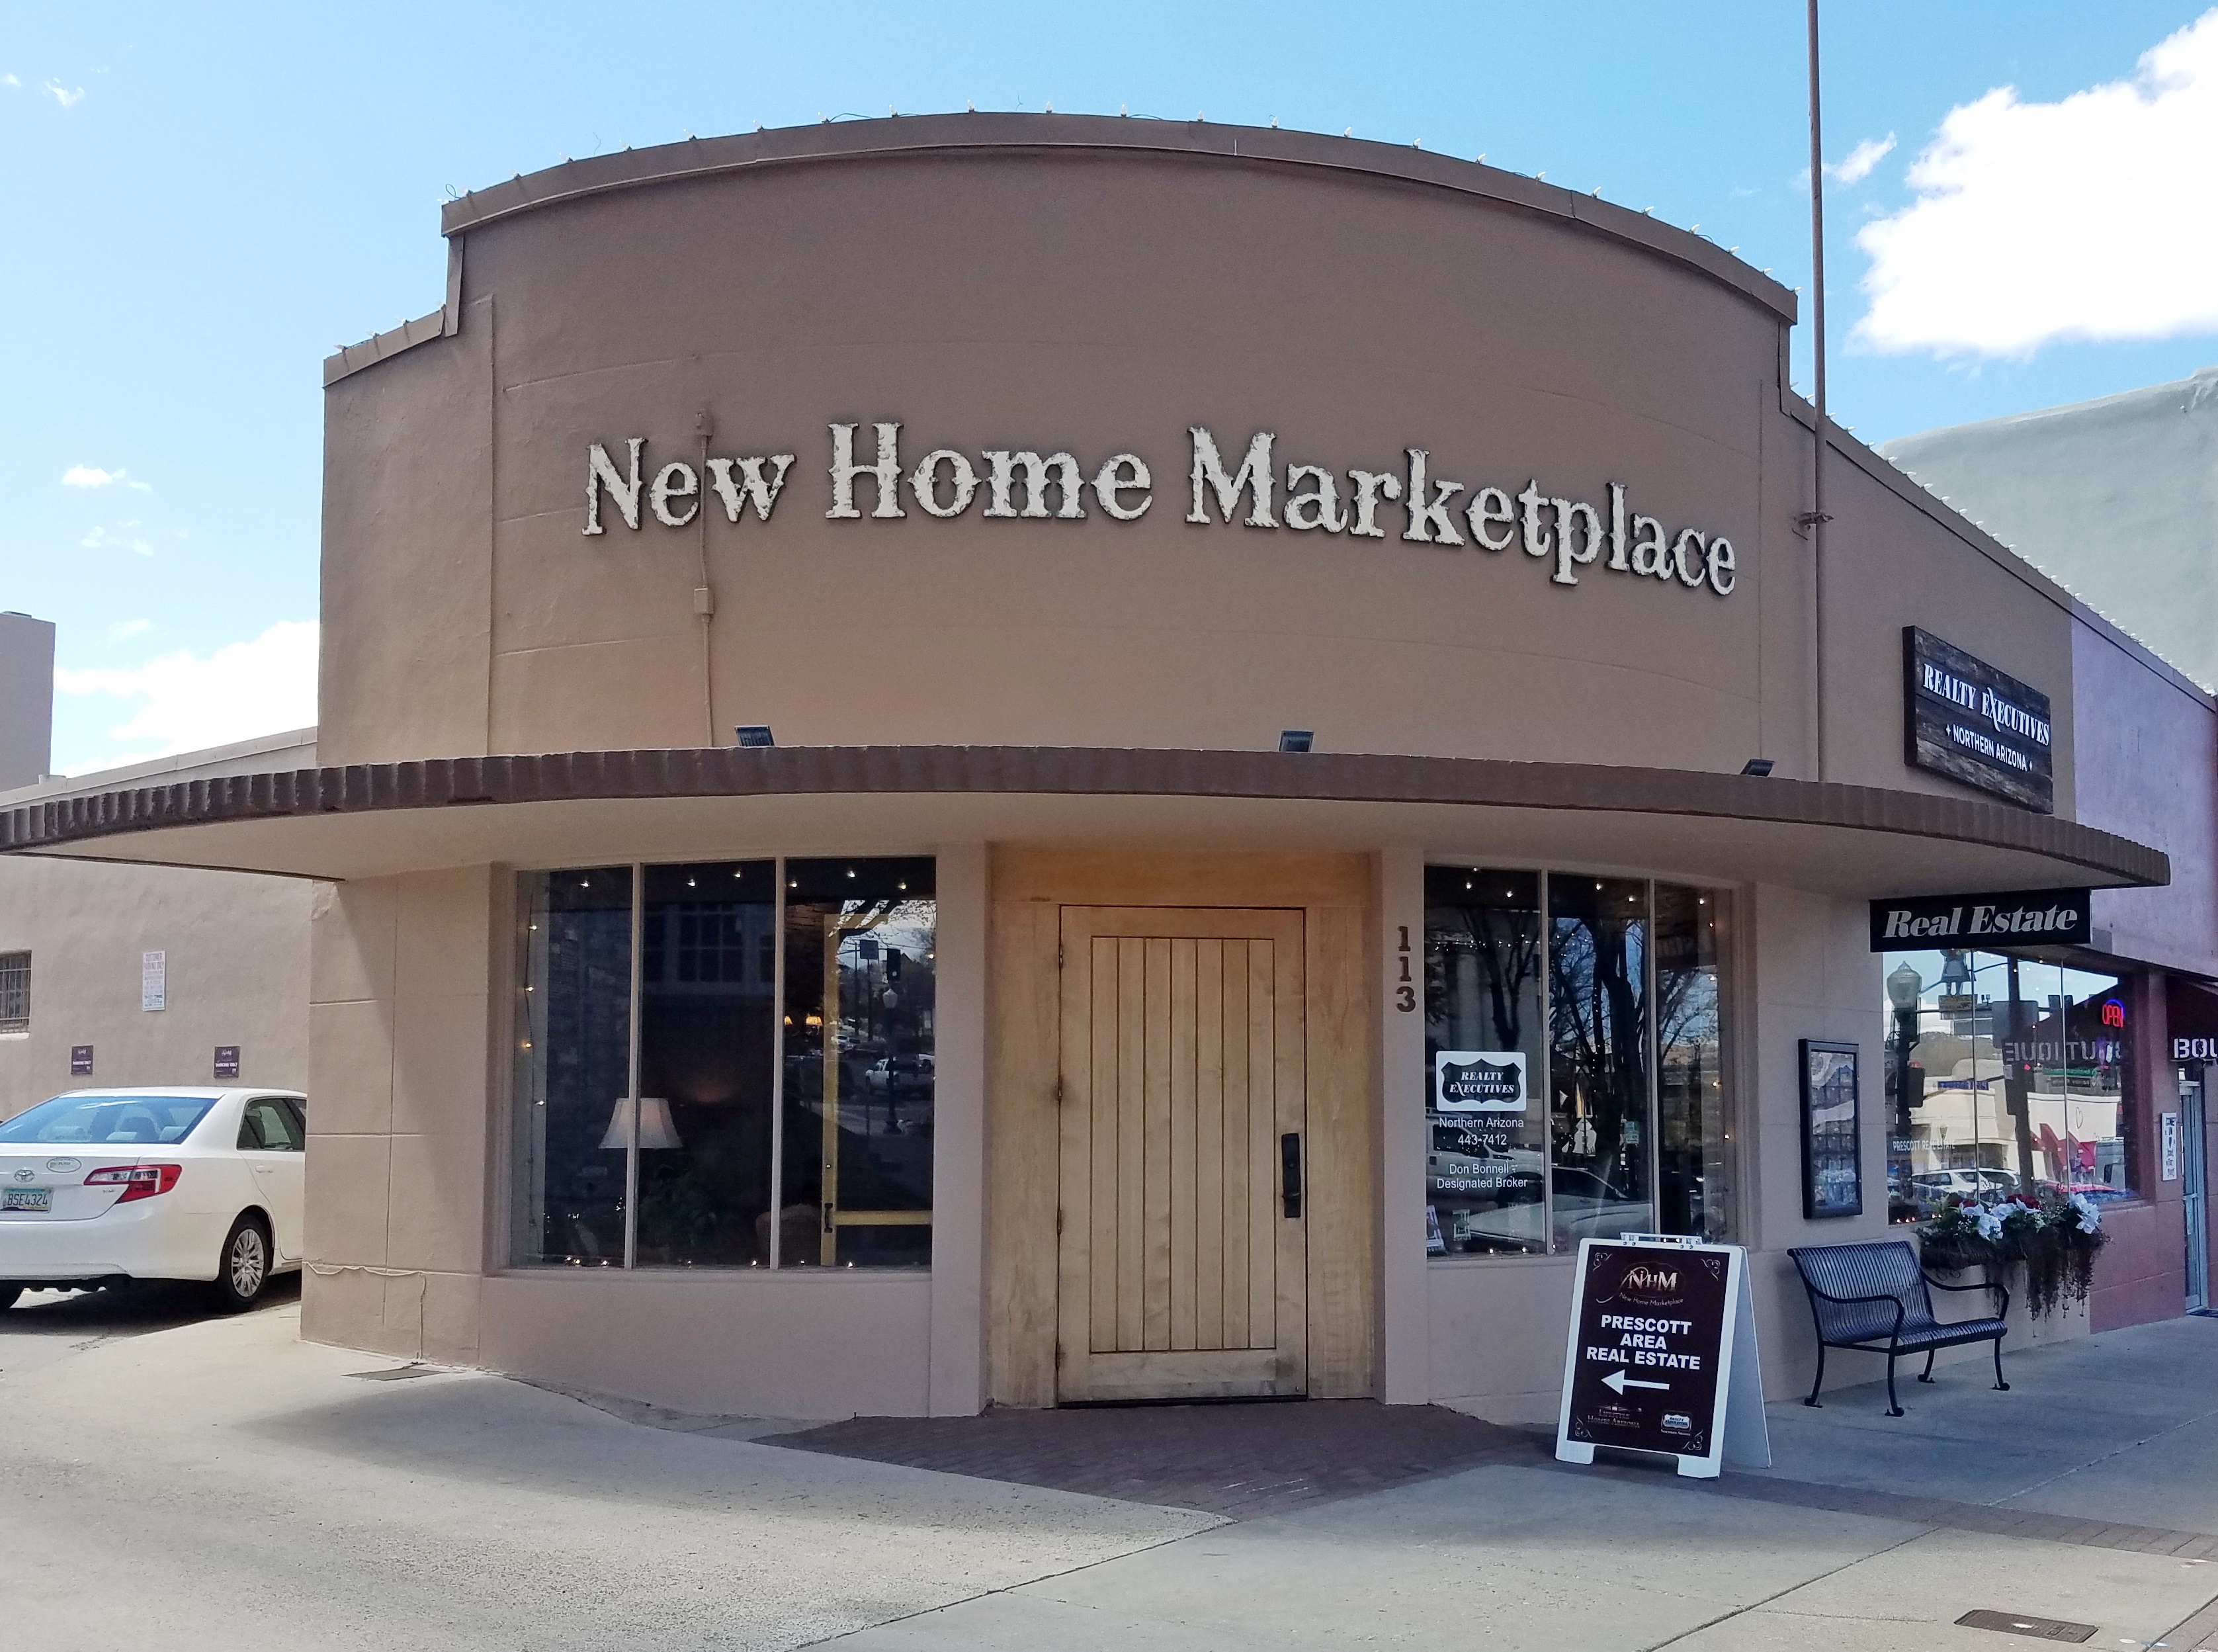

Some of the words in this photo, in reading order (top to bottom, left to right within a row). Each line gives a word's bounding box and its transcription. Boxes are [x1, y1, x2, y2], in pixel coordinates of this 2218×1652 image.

[582, 437, 795, 535] New
[825, 421, 1153, 521] Home
[1185, 426, 1736, 597] Marketplace
[1923, 663, 1977, 710] REALTY
[1981, 687, 2049, 746] EXECUTIVES
[1953, 724, 1994, 758] NORTHERN
[1996, 743, 2027, 772] ARIZONA
[1883, 907, 1963, 938] Real
[1967, 904, 2078, 934] Estate
[1396, 926, 1416, 1012] 113
[2102, 1004, 2124, 1028] OPEN
[1461, 1071, 1504, 1081] REALTY
[1449, 1081, 1515, 1096] EXECUTIVES
[1439, 1117, 1484, 1128] Northern
[1486, 1117, 1524, 1128] Arizona
[1457, 1133, 1507, 1145] 443-7412
[1893, 1139, 1920, 1152] PRESCOTT
[1449, 1163, 1470, 1175] Don
[1472, 1162, 1509, 1175] Bonnell
[1437, 1178, 1492, 1191] Designated
[1496, 1177, 1528, 1188] Broker
[7, 1193, 48, 1206] BSE4324
[1619, 1292, 1632, 1302] New
[1633, 1297, 1649, 1306] Home
[1650, 1297, 1684, 1307] Marketplace
[1601, 1314, 1692, 1335] PRESCOTT
[1620, 1332, 1667, 1350] AREA
[1586, 1346, 1630, 1364] REAL
[1634, 1350, 1701, 1370] ESTATE
